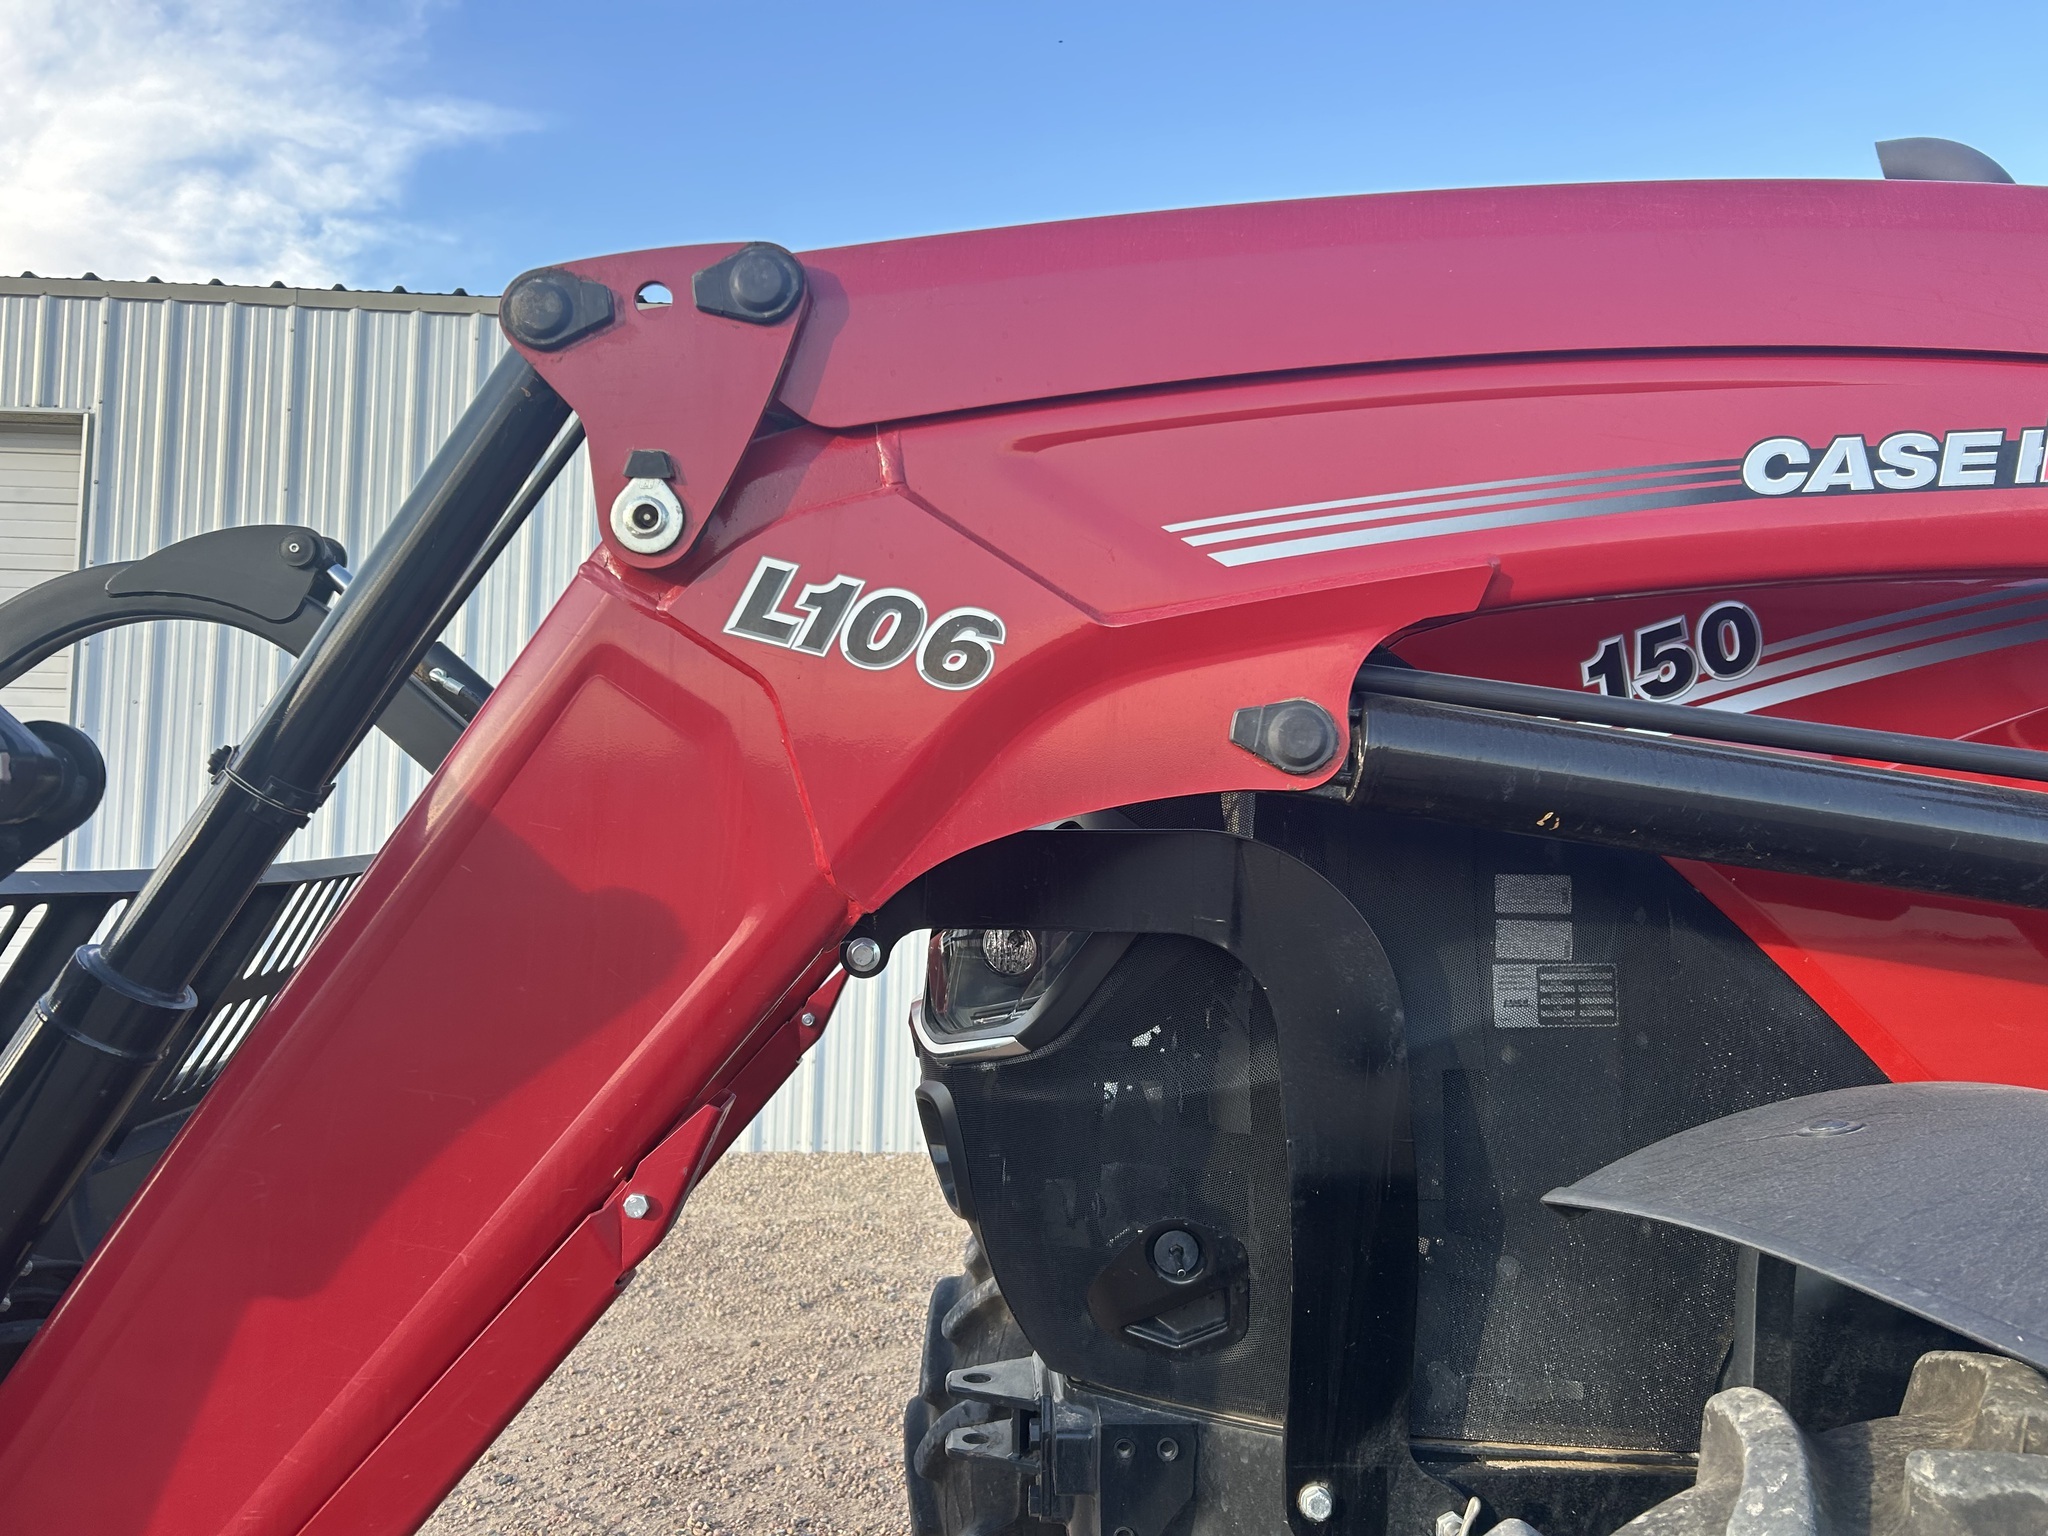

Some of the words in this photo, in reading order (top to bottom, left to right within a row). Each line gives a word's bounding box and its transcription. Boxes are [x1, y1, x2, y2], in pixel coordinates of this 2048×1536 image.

[1742, 429, 2004, 495] CASE
[723, 556, 1006, 690] L106
[1581, 600, 1763, 703] 150
